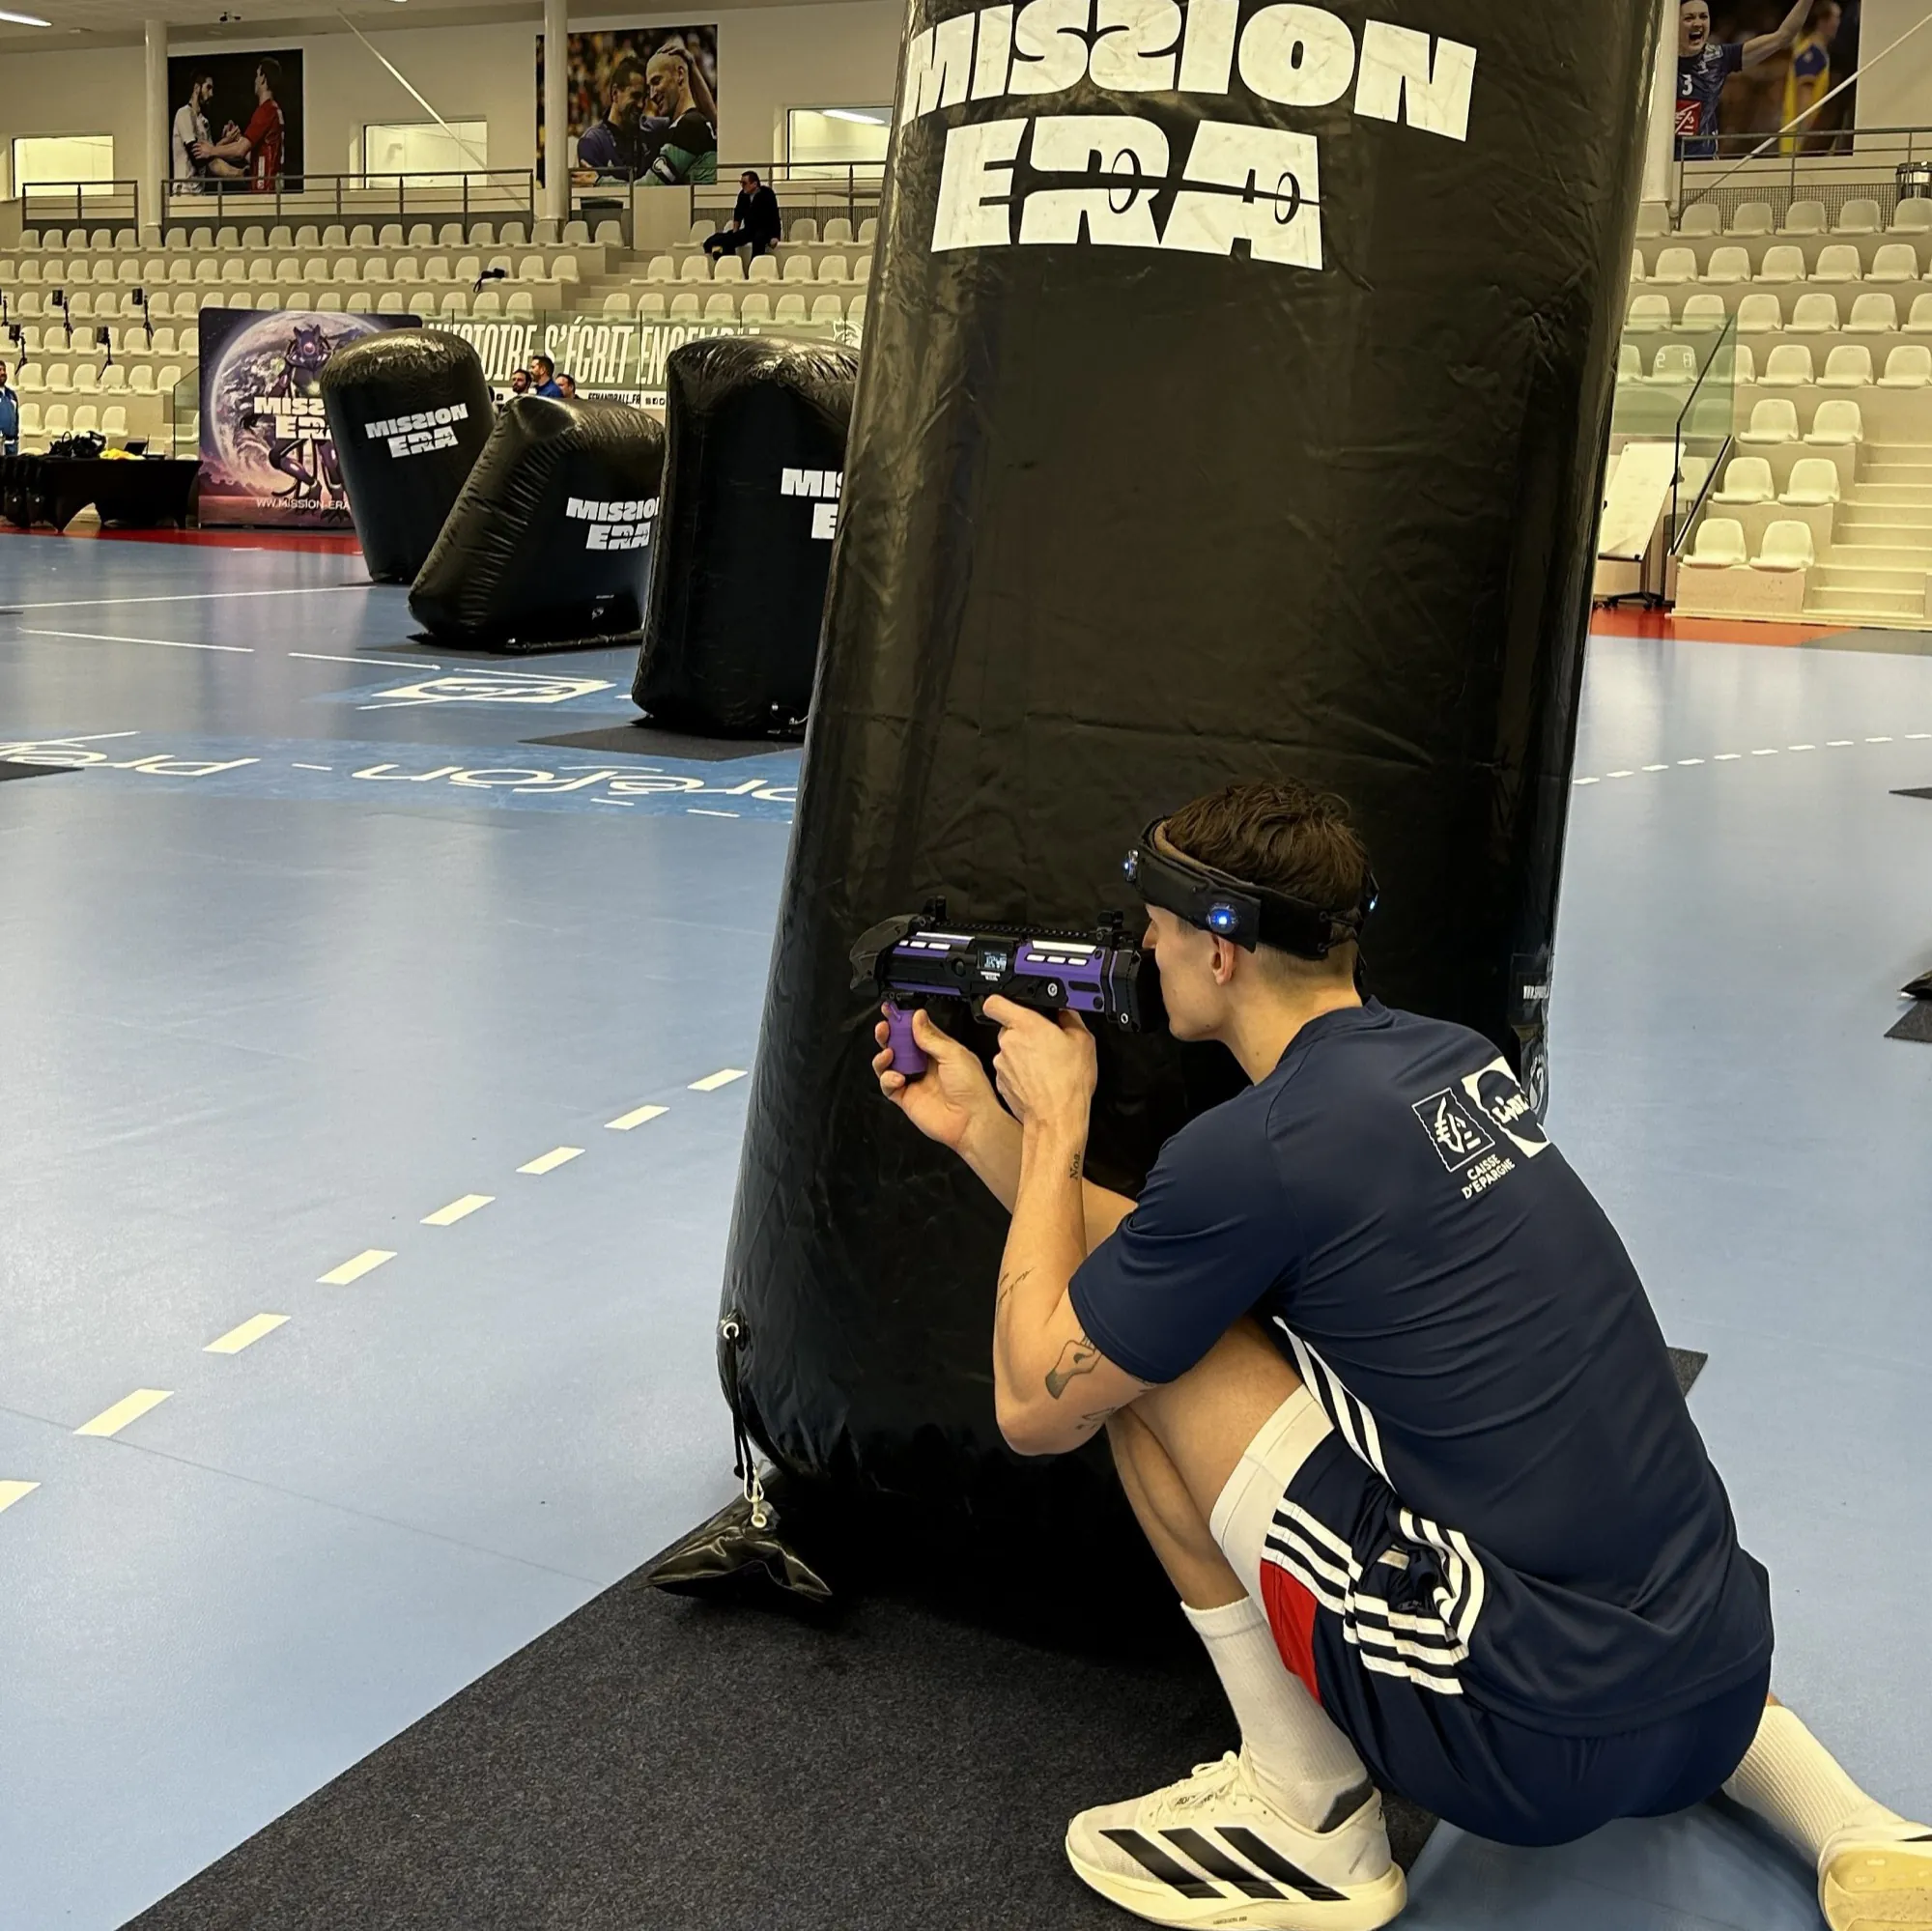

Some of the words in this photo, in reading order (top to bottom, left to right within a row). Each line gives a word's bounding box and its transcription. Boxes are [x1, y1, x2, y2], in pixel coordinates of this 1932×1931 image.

[902, 0, 1477, 142] MISSION
[931, 115, 1322, 270] ERA
[364, 403, 469, 440] MISSION
[387, 425, 459, 459] ERA
[585, 522, 652, 551] ERA
[1466, 1153, 1501, 1180] CAISSE
